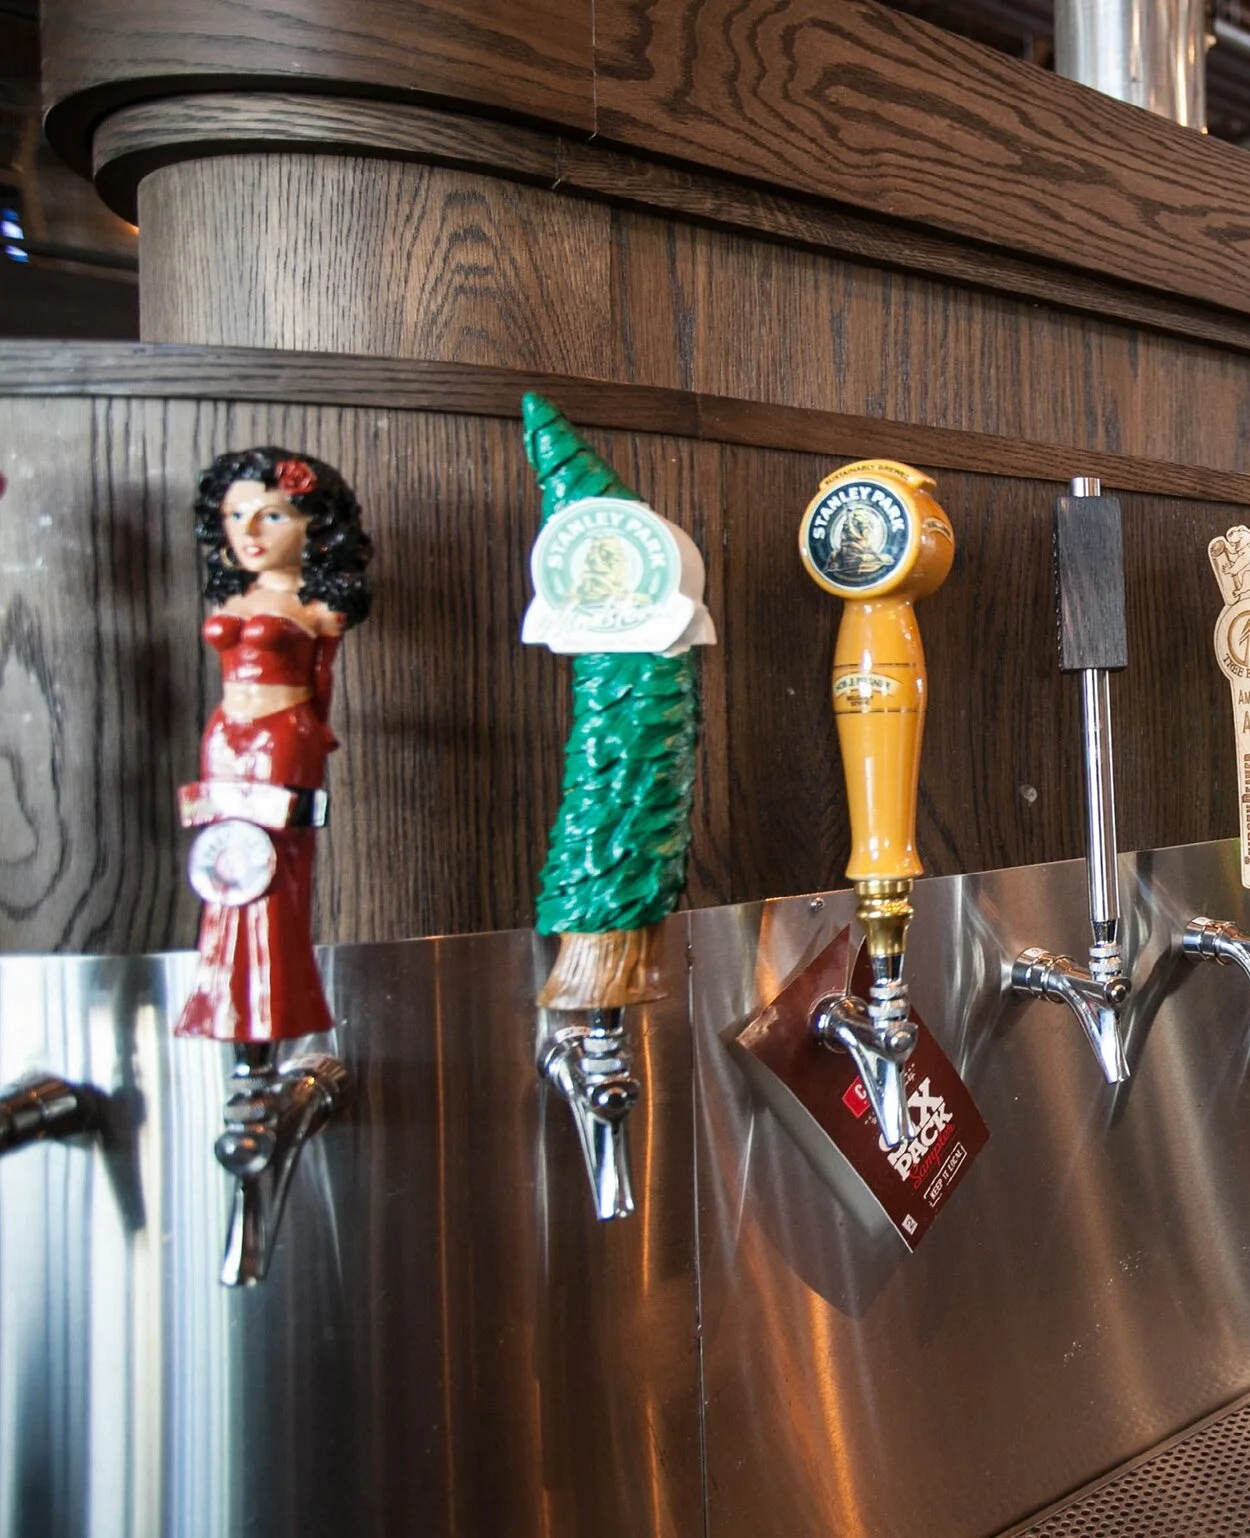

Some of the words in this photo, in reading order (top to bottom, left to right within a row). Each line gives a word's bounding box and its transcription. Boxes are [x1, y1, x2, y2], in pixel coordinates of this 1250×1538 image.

[547, 511, 625, 569] STANLEY
[625, 518, 666, 569] PARK
[812, 486, 872, 540] STANLEY
[871, 490, 905, 533] PARK
[1223, 653, 1243, 678] TREE
[879, 1077, 944, 1166] SX
[894, 1102, 953, 1182] PACK
[910, 1123, 955, 1190] Sampler
[930, 1179, 943, 1200] KEEP
[942, 1170, 949, 1180] IT
[947, 1150, 962, 1172] LOCAL
